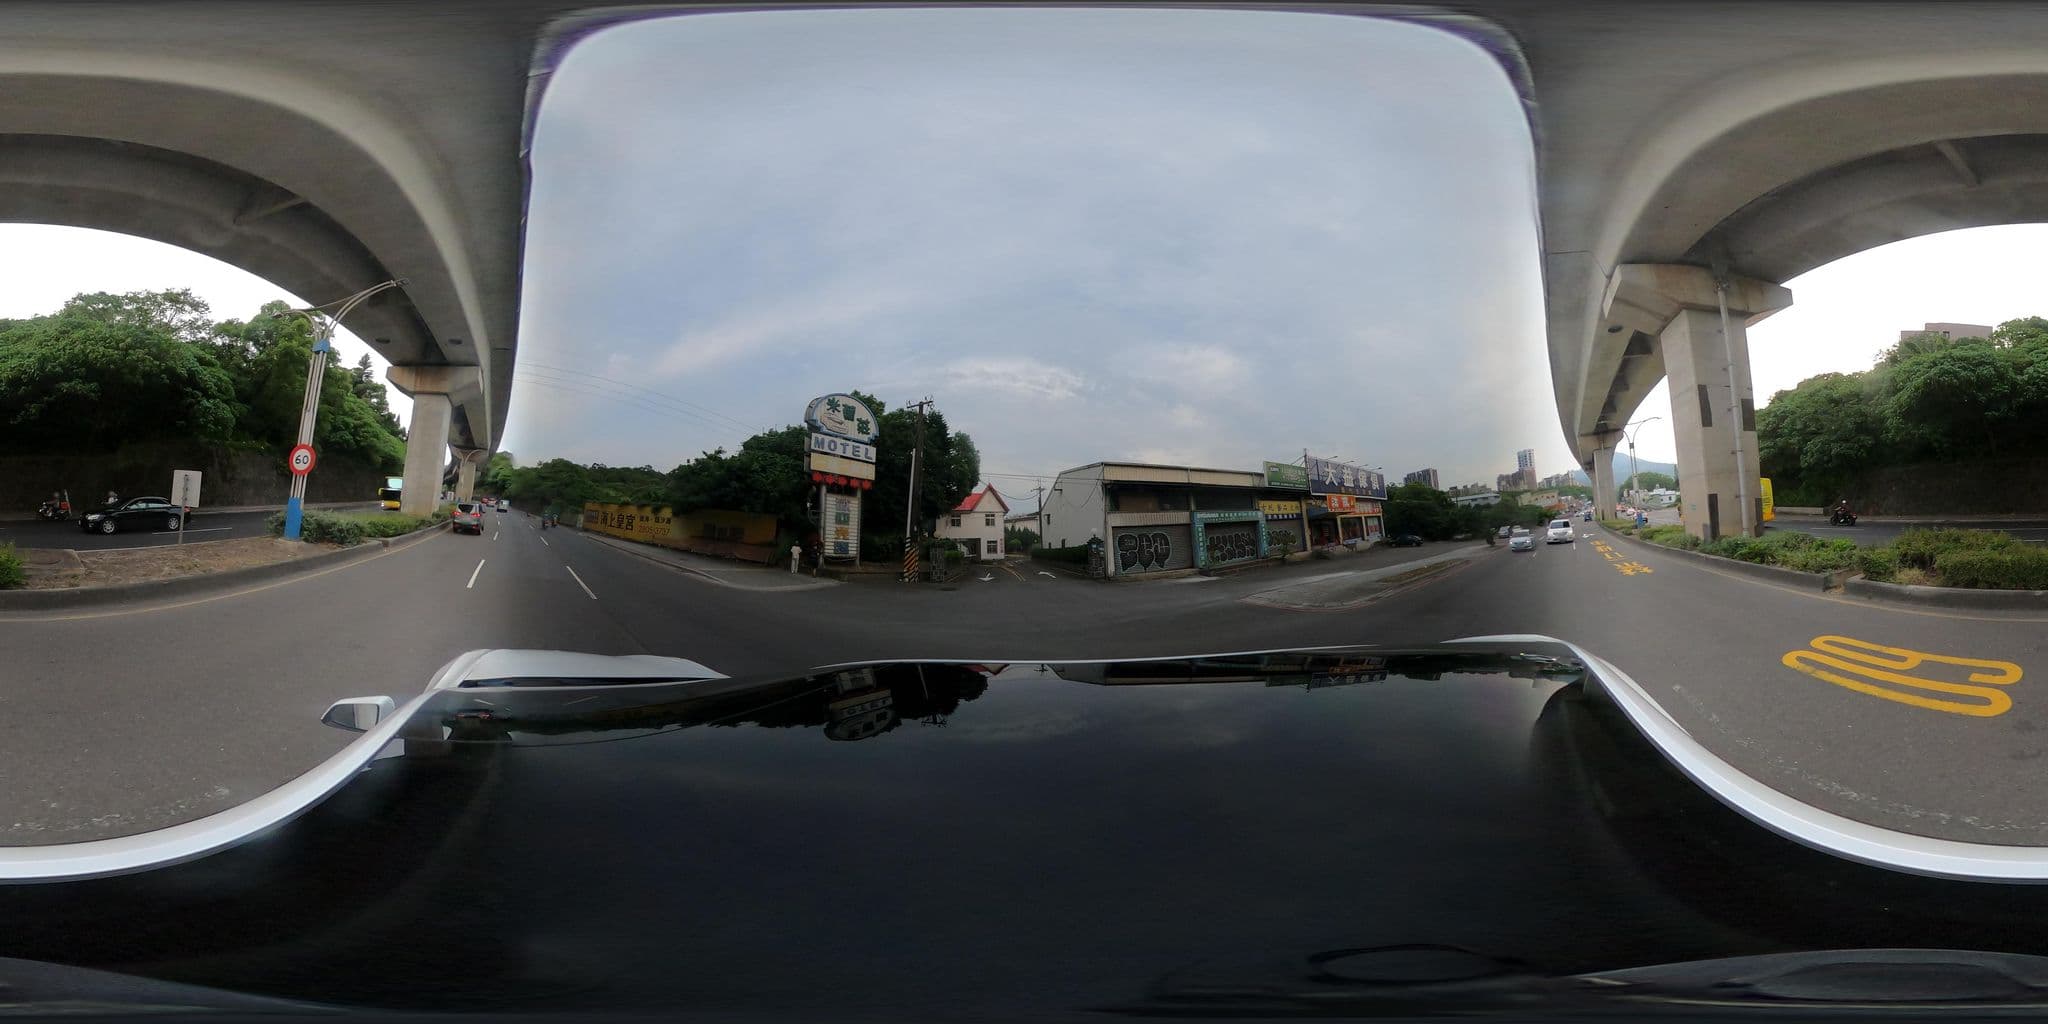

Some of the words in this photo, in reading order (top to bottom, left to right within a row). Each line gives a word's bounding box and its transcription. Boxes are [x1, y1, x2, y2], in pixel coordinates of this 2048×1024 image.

[295, 455, 309, 464] 60
[814, 437, 873, 460] MOTEL
[1781, 635, 2023, 717] 60
